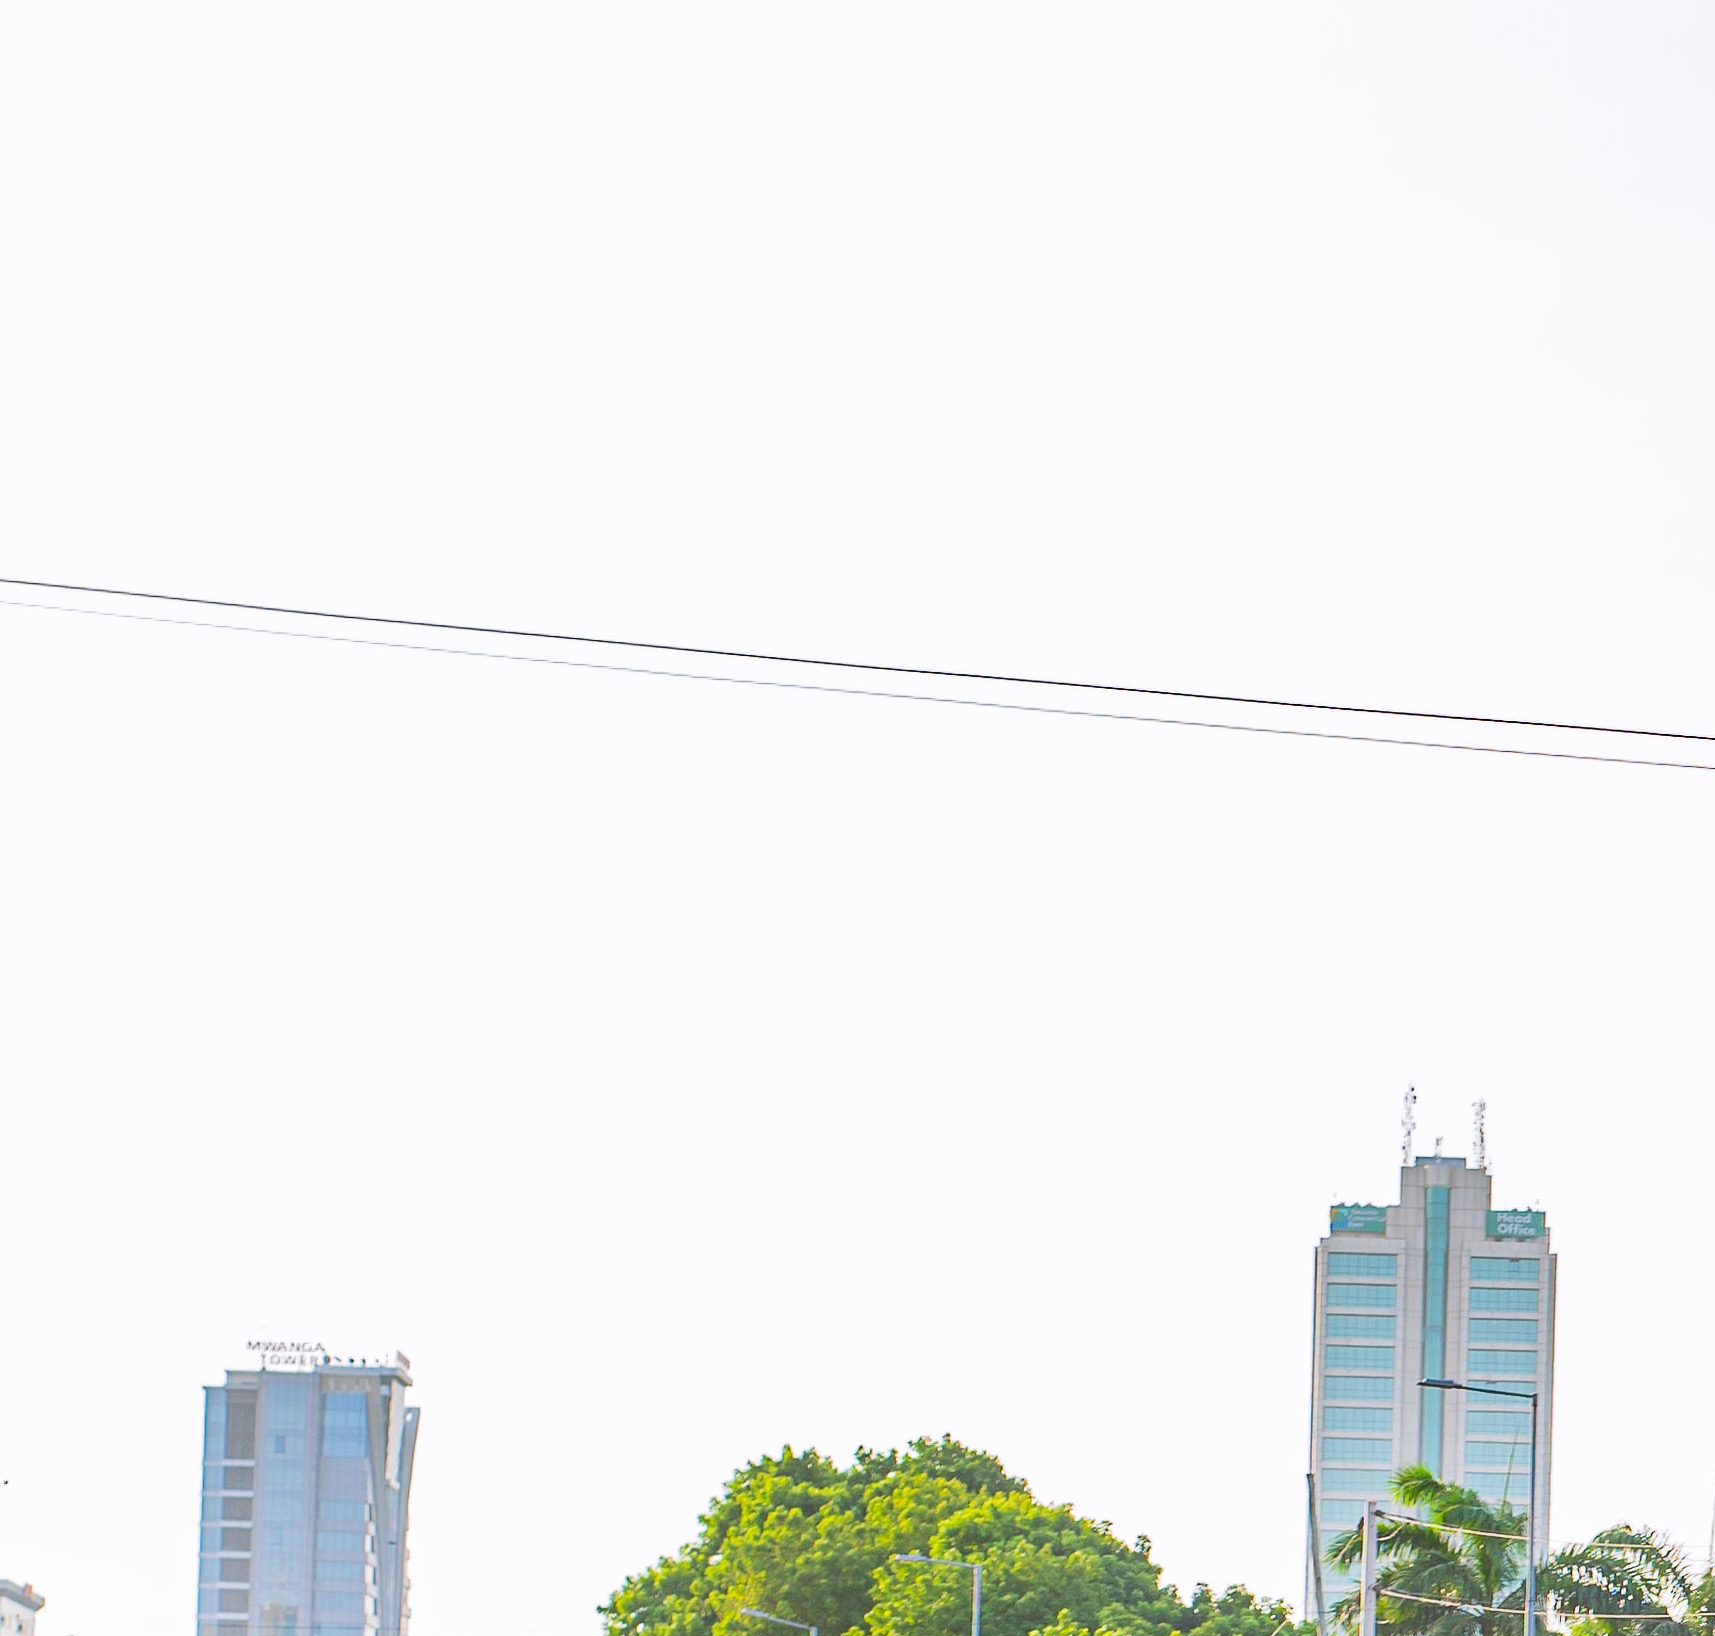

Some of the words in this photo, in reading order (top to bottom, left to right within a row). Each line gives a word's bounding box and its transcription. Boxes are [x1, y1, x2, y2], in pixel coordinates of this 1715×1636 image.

[1496, 1212, 1532, 1223] Head
[1496, 1223, 1536, 1235] Office
[247, 1341, 325, 1352] MWANGA
